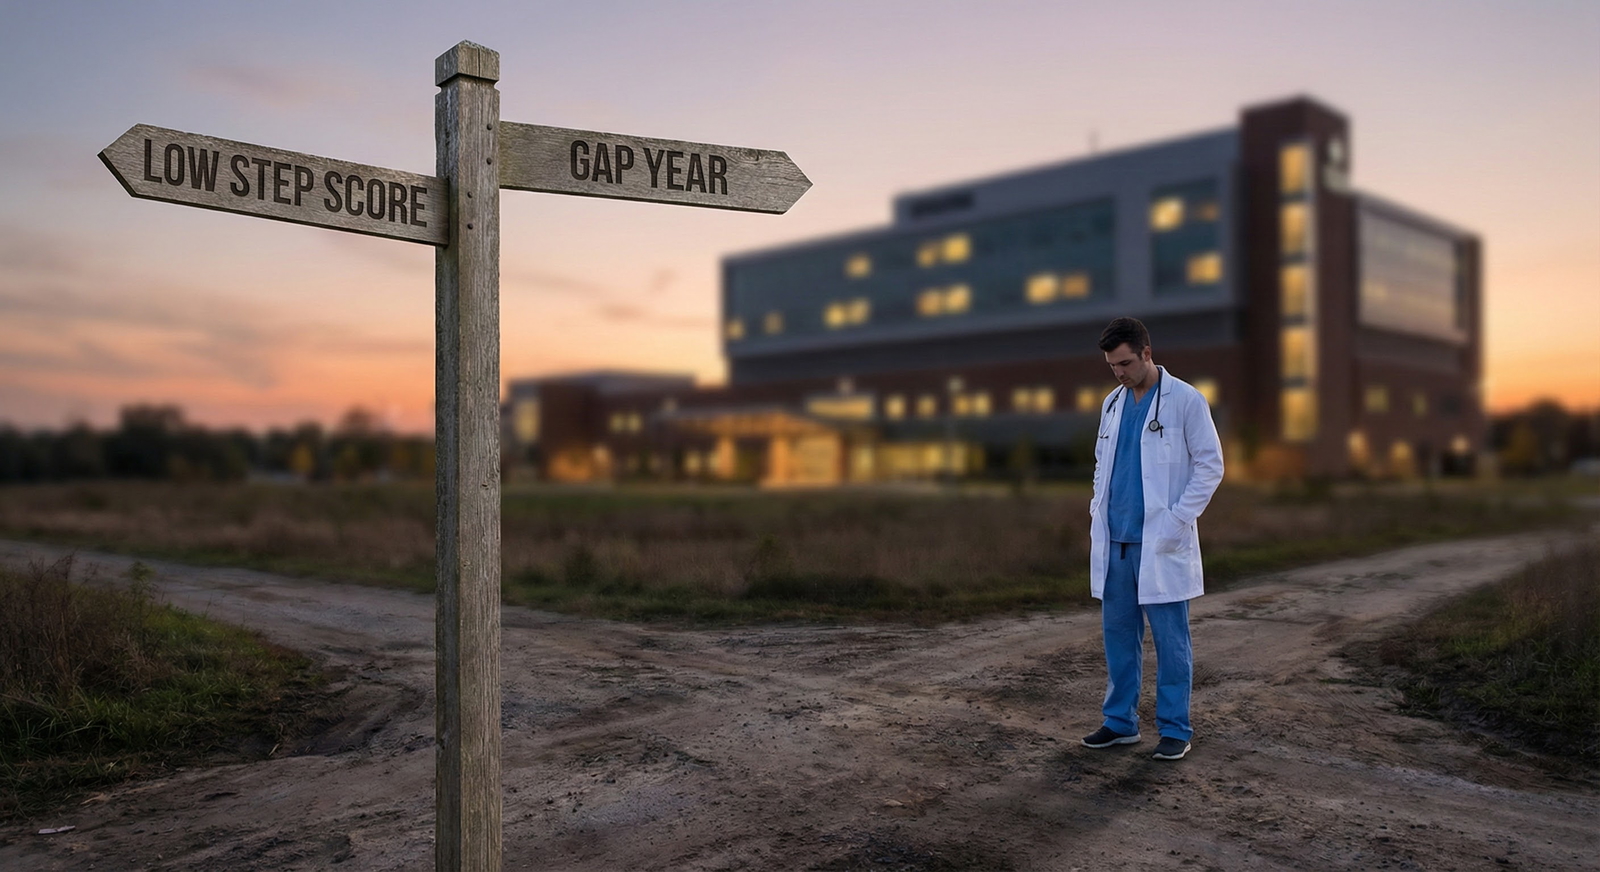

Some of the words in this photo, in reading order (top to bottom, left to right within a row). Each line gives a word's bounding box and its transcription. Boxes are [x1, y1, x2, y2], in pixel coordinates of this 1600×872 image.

[143, 138, 219, 192] LOW
[230, 154, 314, 206] STEP
[323, 170, 428, 228] SCORE
[570, 140, 634, 185] GAP
[643, 147, 728, 196] YEAR
